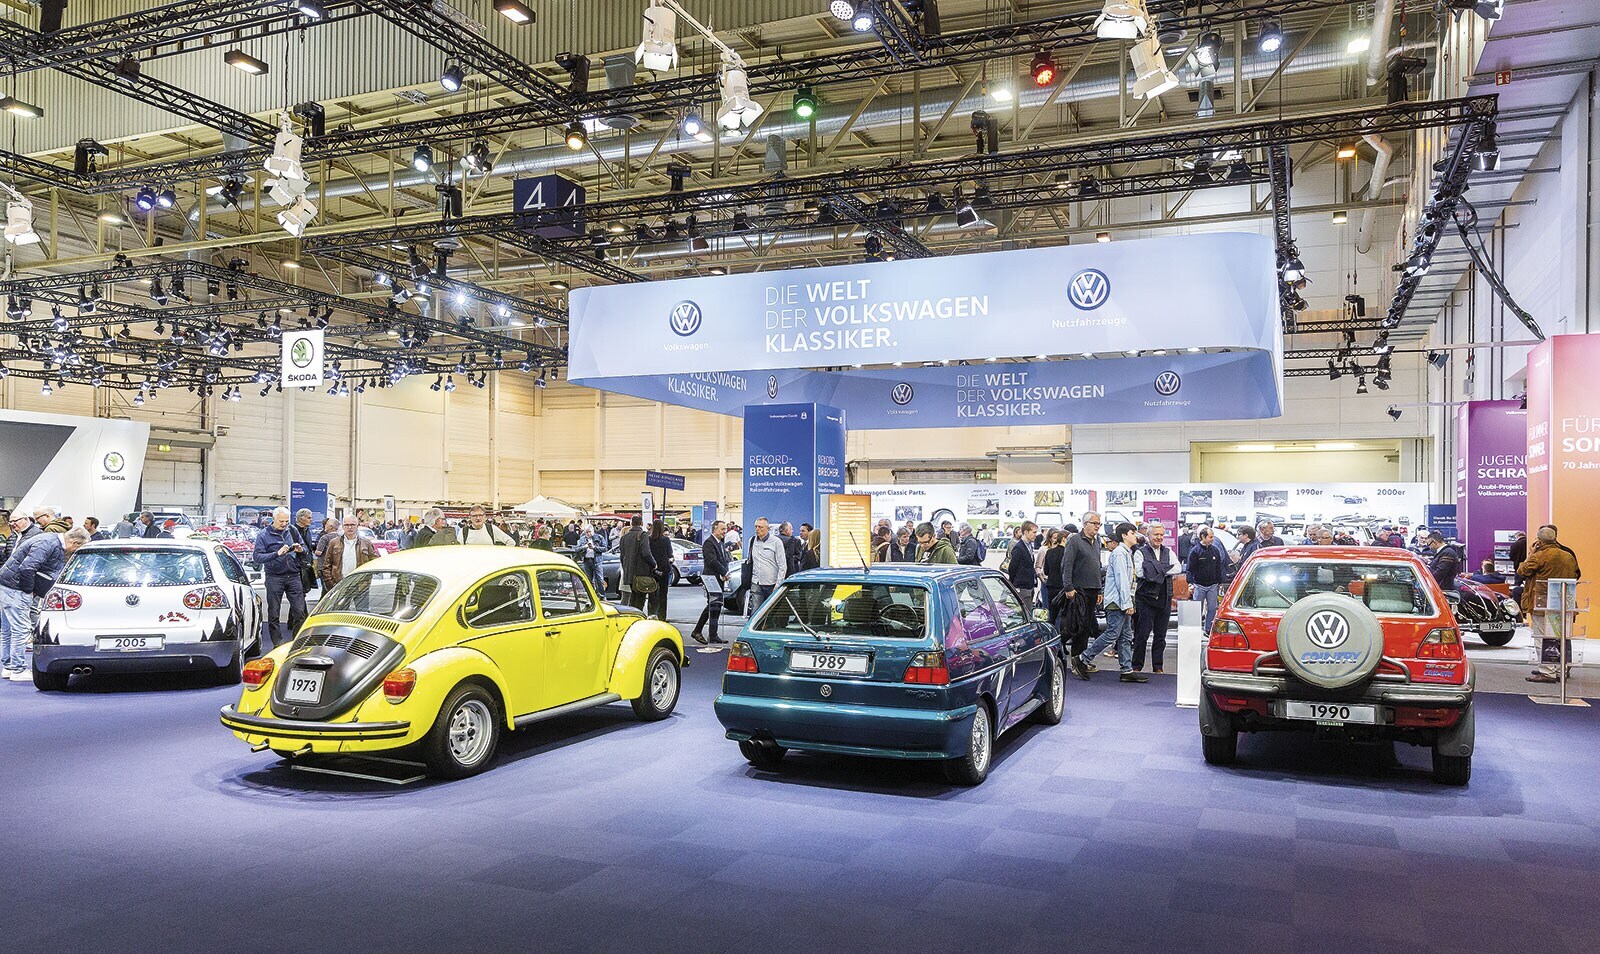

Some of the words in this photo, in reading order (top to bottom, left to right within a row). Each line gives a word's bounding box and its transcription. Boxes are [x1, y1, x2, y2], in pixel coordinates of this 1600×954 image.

[524, 182, 546, 222] 4
[765, 284, 798, 306] DIE
[806, 279, 871, 302] WELT
[765, 308, 808, 330] DER
[814, 295, 989, 326] VOLKSWAGEN
[1052, 316, 1127, 328] Nutzfahrzeuge
[664, 342, 709, 352] Volkswagen
[765, 327, 898, 353] KLASSIKER.
[288, 373, 318, 382] ŠKODA
[957, 374, 979, 388] DIE
[984, 372, 1028, 386] WELT
[668, 377, 719, 402] KLASSIKER.
[957, 390, 986, 402] DER
[990, 385, 1105, 401] VOLKSWAGEN
[957, 403, 1046, 418] KLASSIKER.
[750, 455, 792, 464] REKORD-
[1562, 461, 1576, 469] 70
[750, 467, 800, 476] BRECHER.
[818, 466, 840, 477] BRECHER.
[1308, 611, 1348, 647] VW
[115, 639, 146, 648] 2005
[811, 655, 846, 669] 1989
[1301, 651, 1361, 664] COUNTRY
[292, 679, 317, 692] 1973
[1310, 705, 1350, 719] 1990
